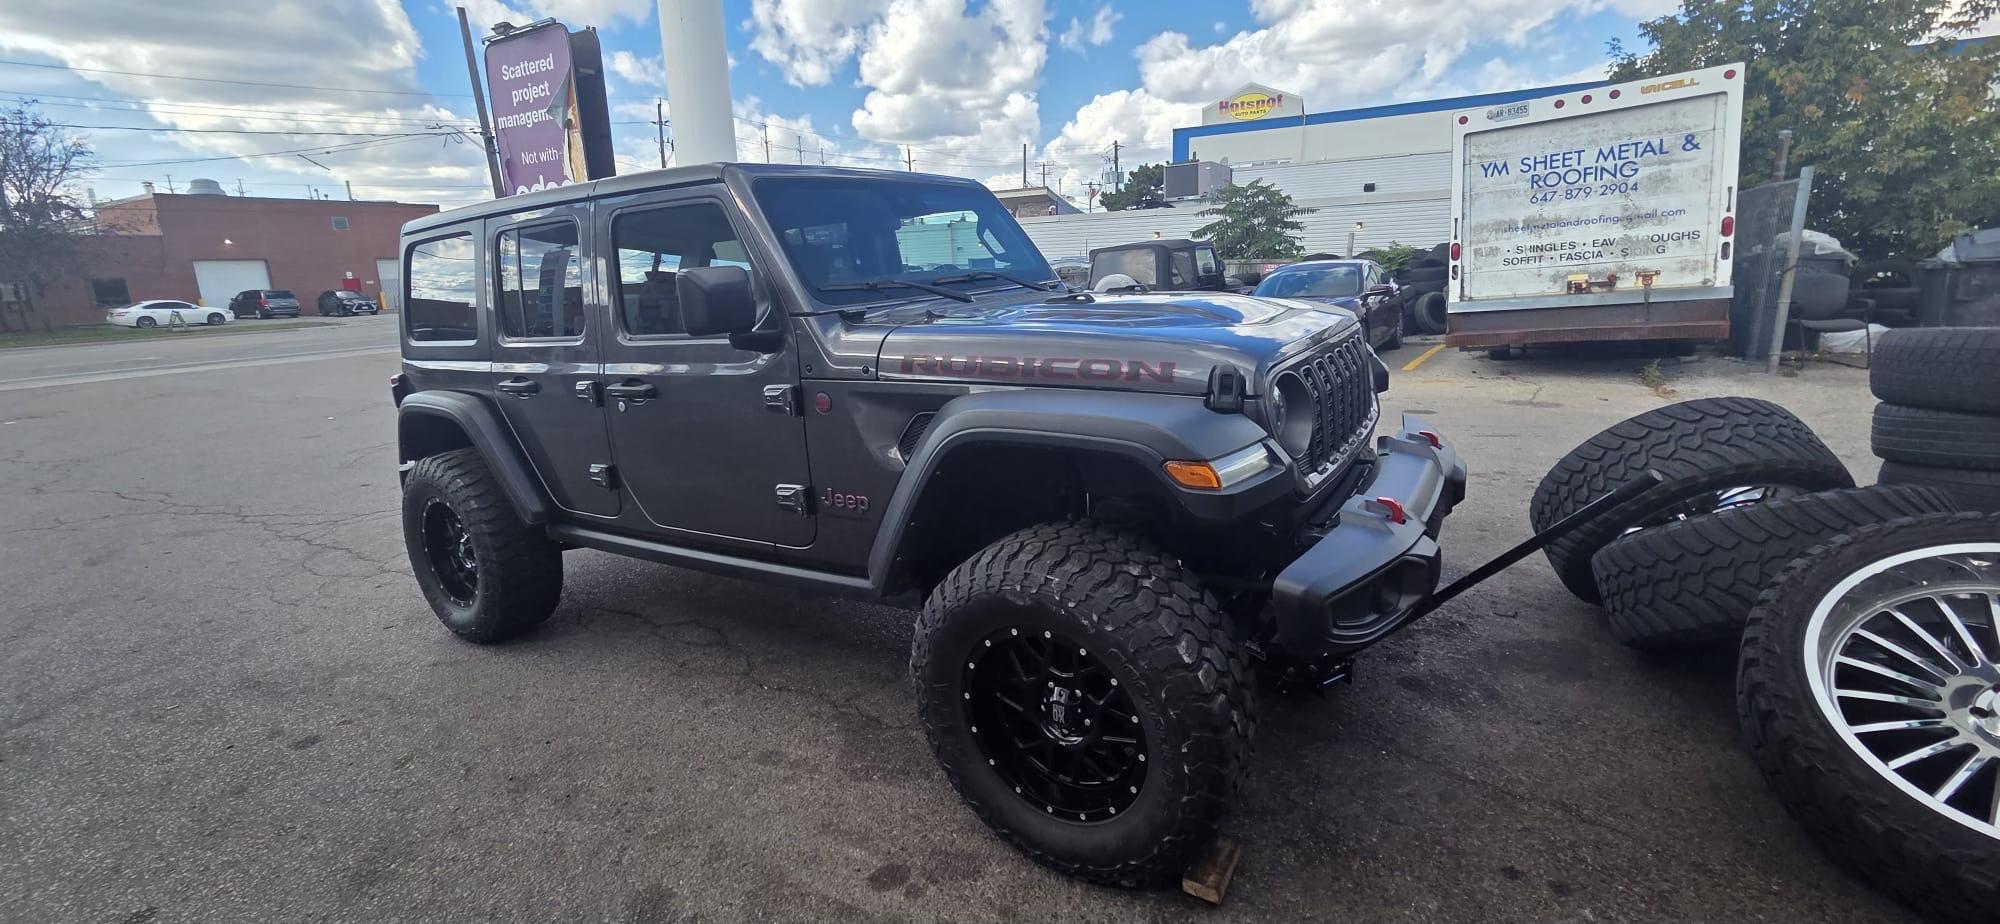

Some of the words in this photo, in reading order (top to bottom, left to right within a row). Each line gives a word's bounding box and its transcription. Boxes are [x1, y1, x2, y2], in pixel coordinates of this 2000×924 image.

[502, 53, 554, 80] Scattered
[512, 81, 550, 106] project
[1218, 94, 1283, 115] Hotspot
[498, 108, 553, 130] managem
[521, 151, 538, 165] Not
[539, 147, 559, 163] with
[1480, 160, 1509, 179] YM
[1520, 150, 1586, 174] SHEET
[1595, 138, 1670, 164] METAL
[1682, 134, 1702, 151] &
[1530, 160, 1640, 190] ROOFING
[1529, 181, 1640, 205] 647-879-2904
[1502, 255, 1545, 267] SOFFIT
[1559, 250, 1604, 262] FASCIA
[900, 354, 1177, 384] RUBICON
[821, 487, 869, 513] Jeep
